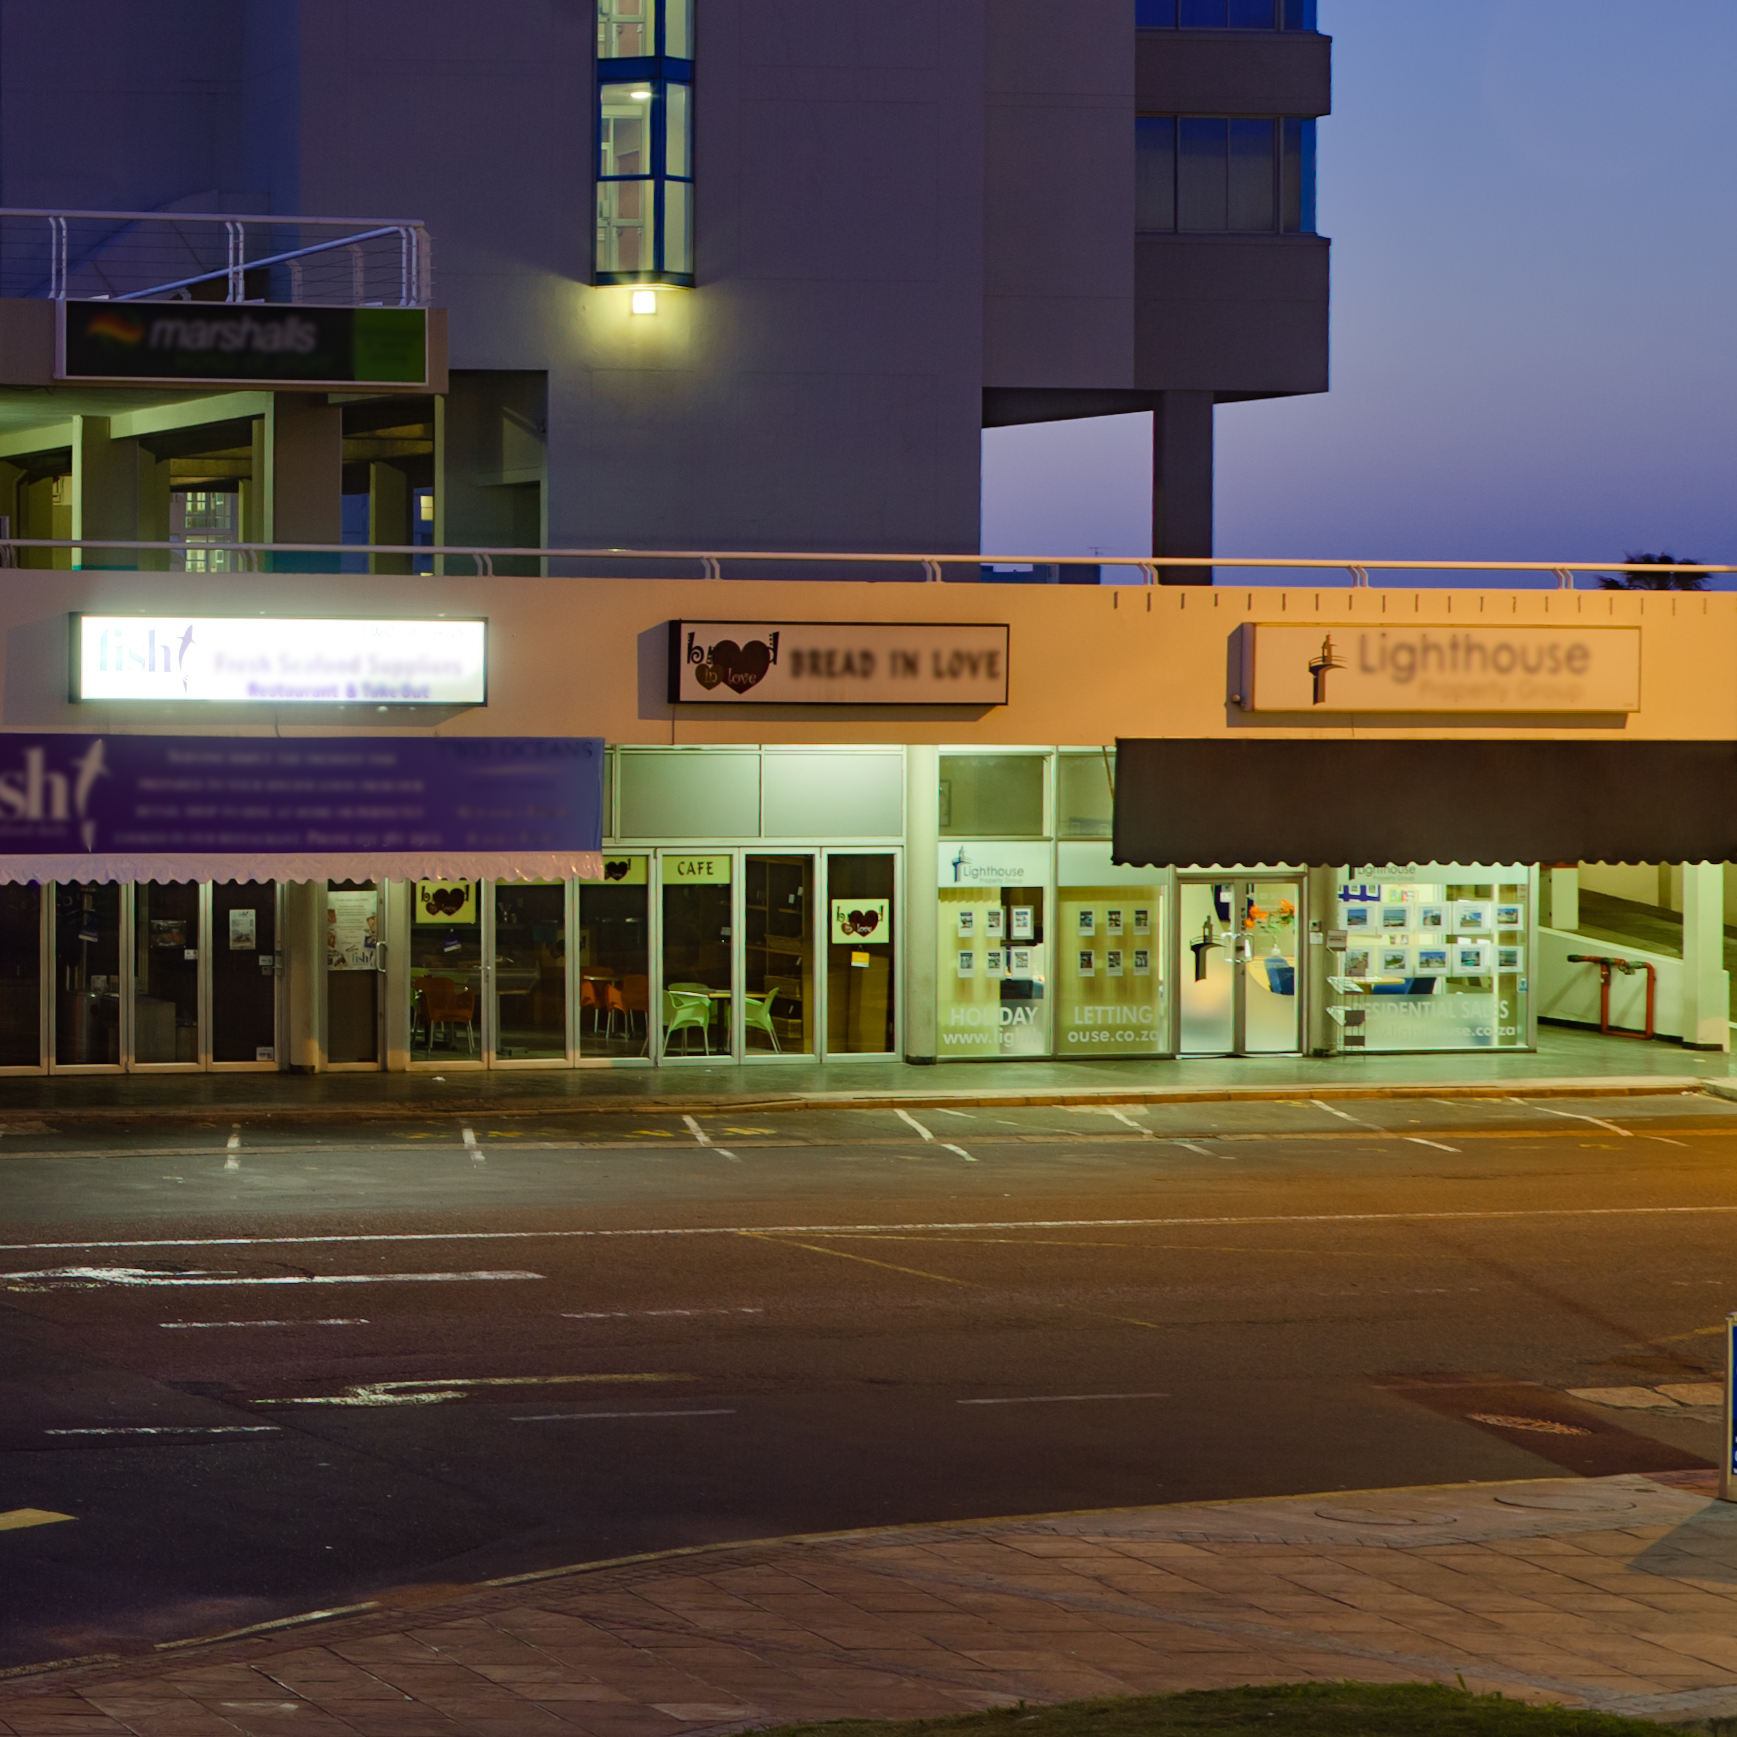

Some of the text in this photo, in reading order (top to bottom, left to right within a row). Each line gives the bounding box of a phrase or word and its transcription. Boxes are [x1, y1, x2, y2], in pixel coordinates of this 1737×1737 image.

[99, 628, 171, 672] fish
[677, 861, 714, 876] CAFE
[963, 865, 1025, 879] Lighthouse
[950, 1005, 1153, 1026] HOLIDAY LETTING
